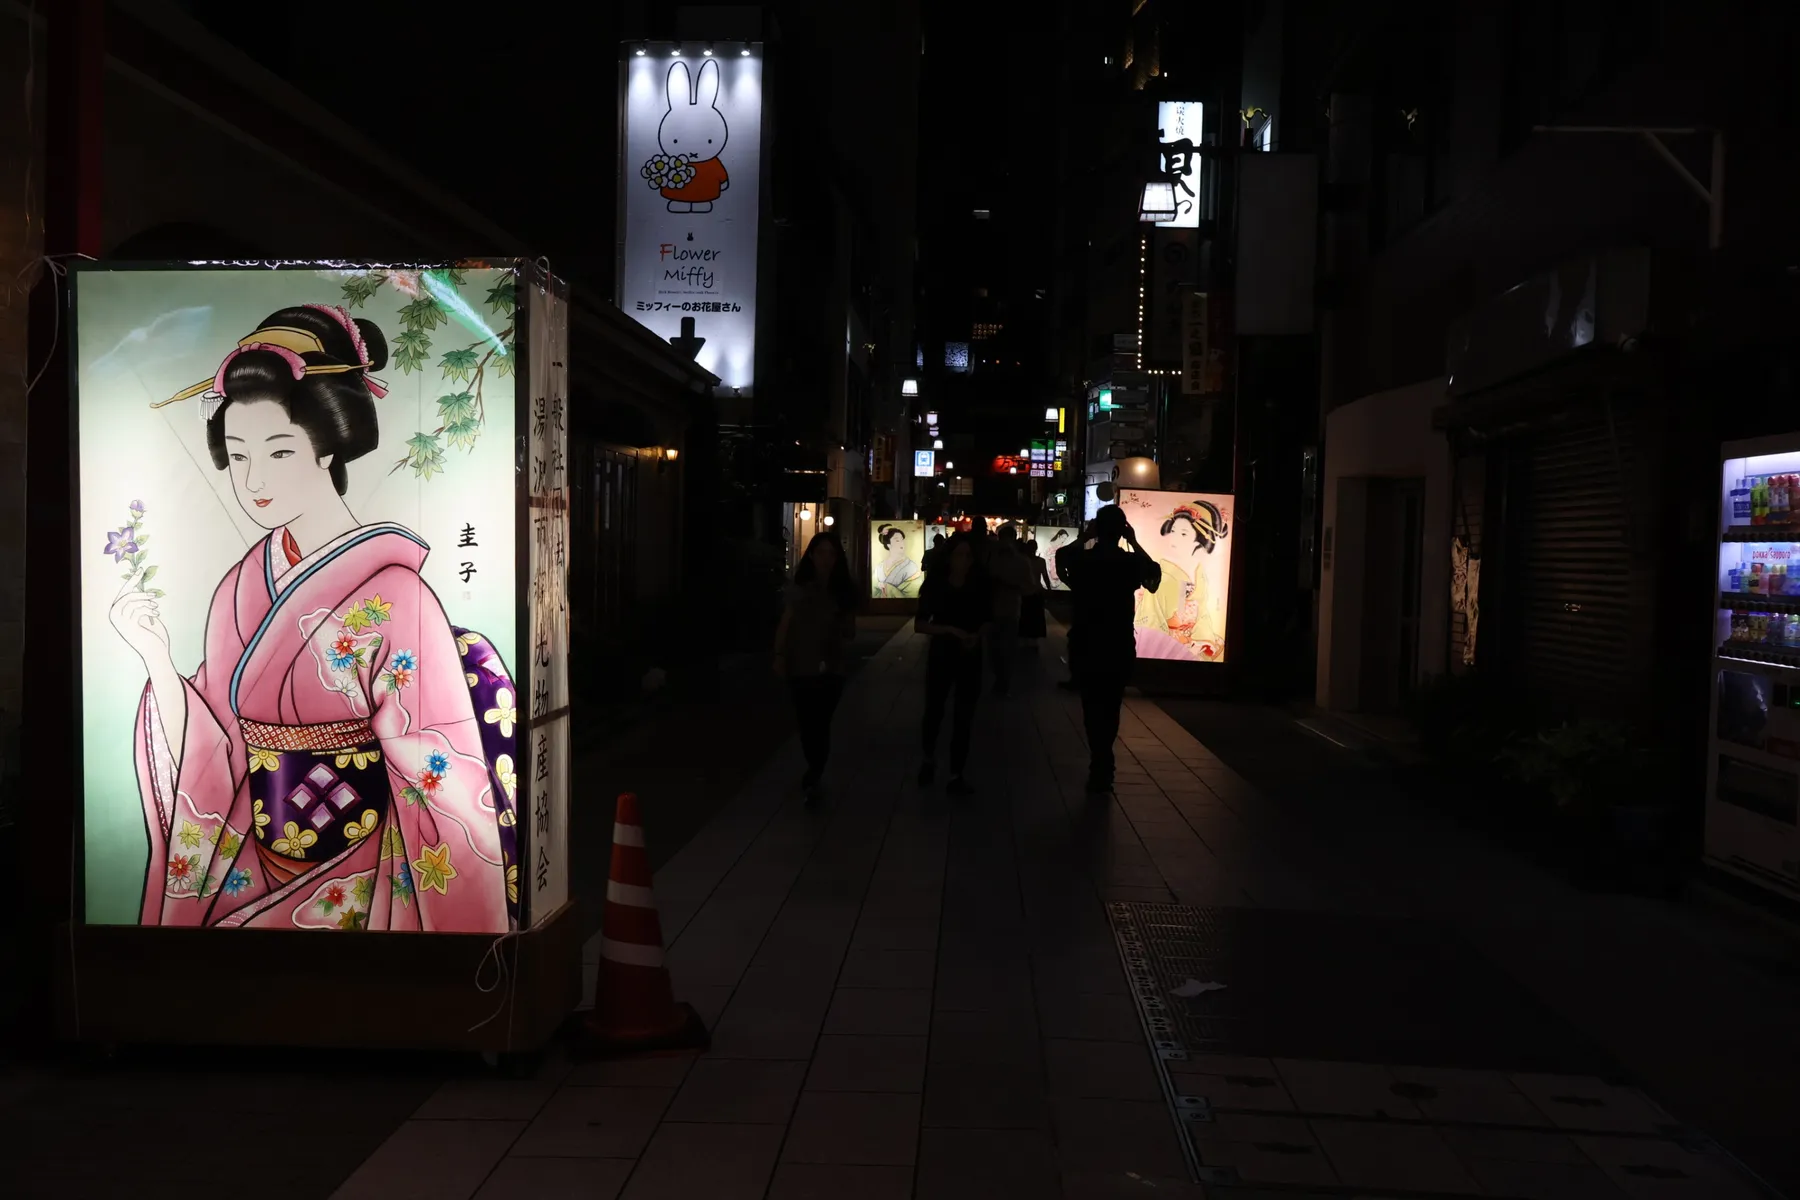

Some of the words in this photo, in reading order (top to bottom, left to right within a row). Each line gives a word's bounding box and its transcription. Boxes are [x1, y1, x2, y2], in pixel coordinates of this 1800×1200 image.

[659, 243, 721, 262] Flower
[663, 265, 714, 289] Miffy
[636, 301, 741, 312] ミッフィーのお花屋さん
[457, 522, 479, 584] 圭子
